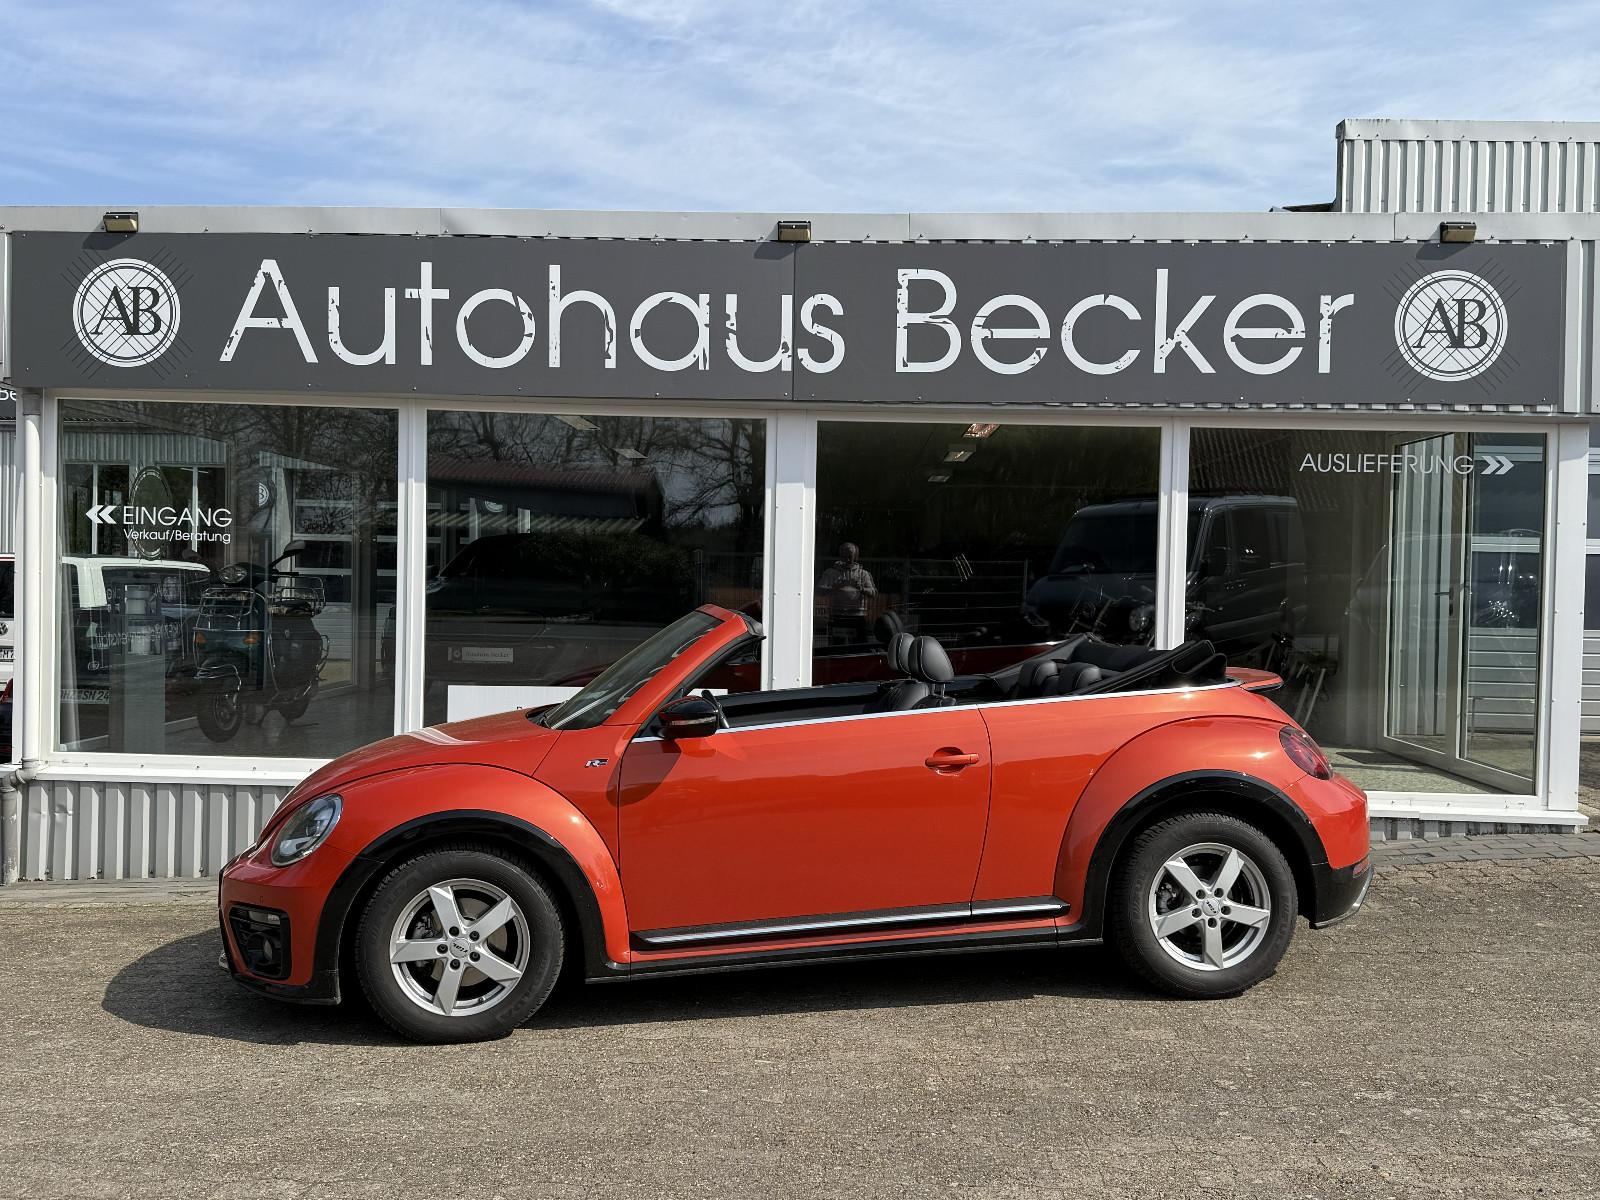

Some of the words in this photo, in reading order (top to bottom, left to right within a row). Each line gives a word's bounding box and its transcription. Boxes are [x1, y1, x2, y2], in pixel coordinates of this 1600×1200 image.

[90, 285, 162, 335] AB
[220, 259, 845, 373] Autohaus
[896, 269, 1354, 374] Becker
[1413, 298, 1488, 348] AB
[1299, 453, 1474, 475] AUSLIEFERUNG
[123, 505, 232, 527] EINGANG
[123, 528, 231, 545] Verkauf/Beratung
